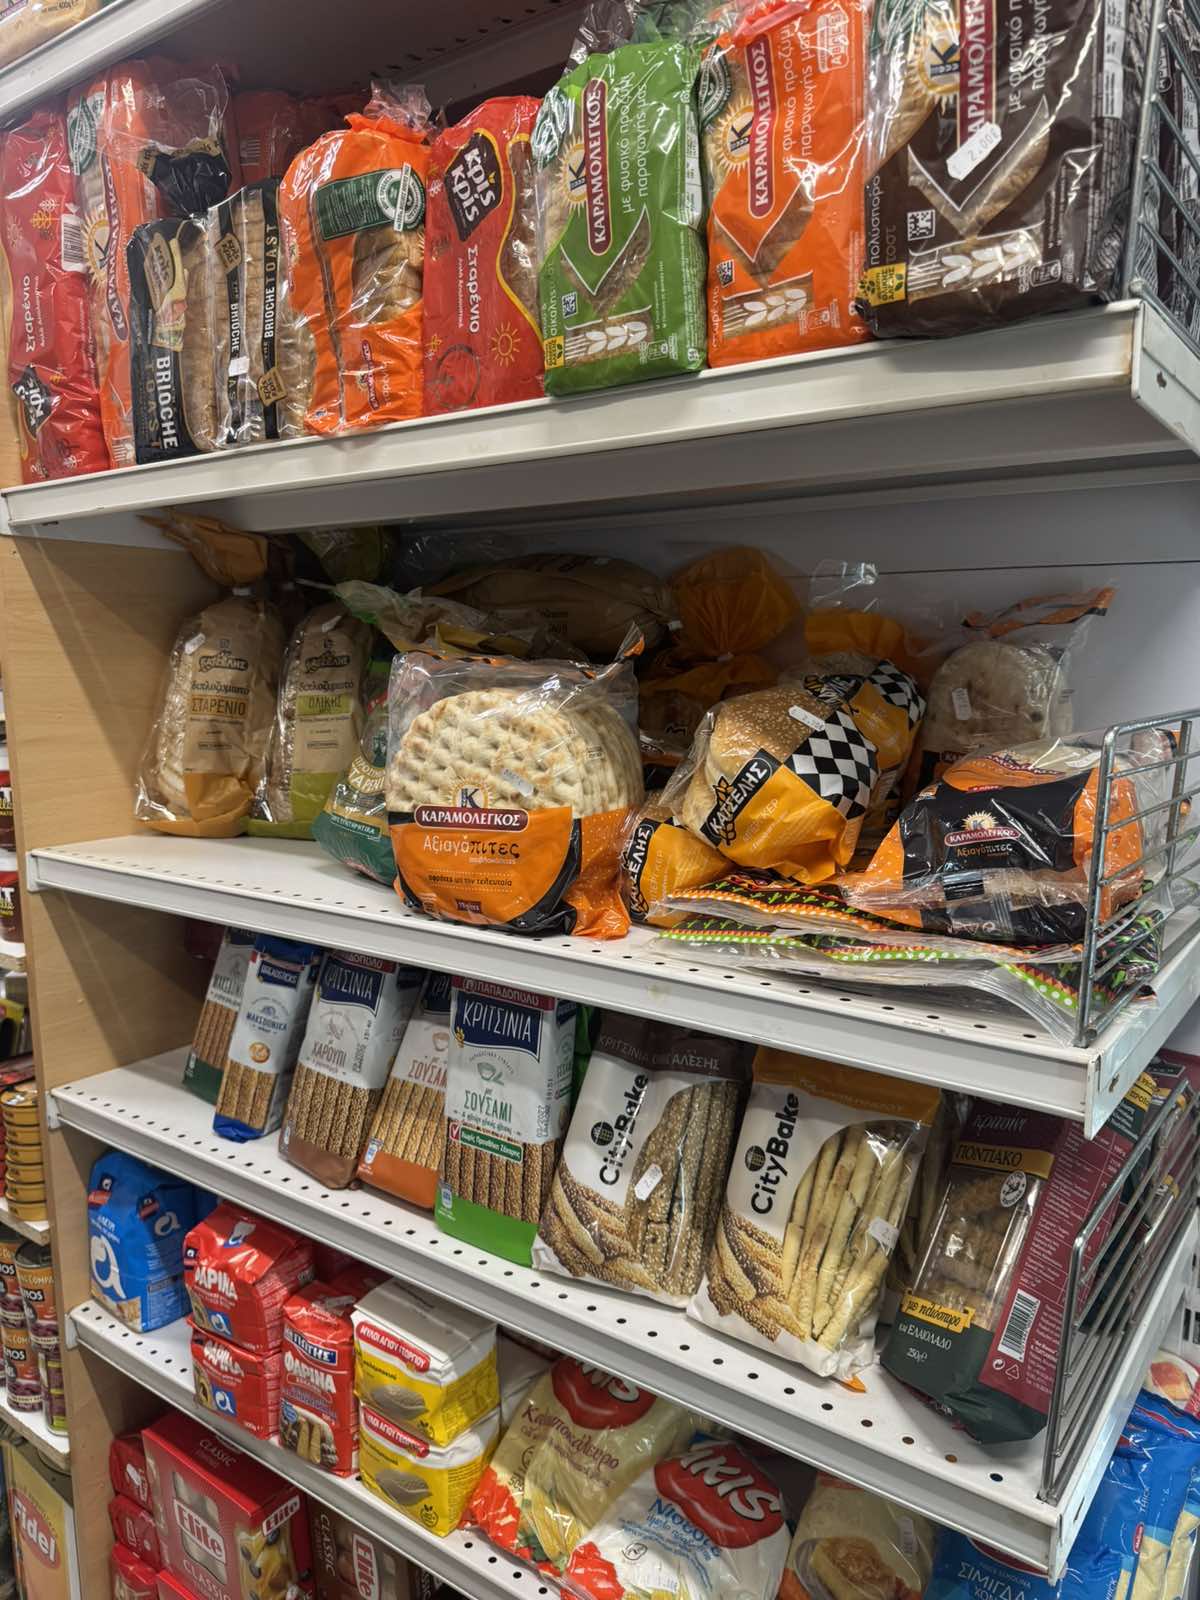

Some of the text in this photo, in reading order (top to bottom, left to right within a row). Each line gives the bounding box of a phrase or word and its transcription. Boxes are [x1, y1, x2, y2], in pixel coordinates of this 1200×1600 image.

[778, 25, 797, 91] προζύμι
[752, 42, 772, 206] ΚΑΡΑΜΟΛΕΓΚΟΣ
[782, 97, 797, 150] φυσικό
[799, 66, 816, 156] παραγωγής
[1008, 91, 1026, 112] με
[588, 89, 606, 243] ΚΑΡΑΜΟΛΕΓΚΟΣ
[618, 138, 633, 191] φυσικό
[634, 84, 651, 196] παραγωγής μας
[623, 196, 635, 213] με
[869, 176, 884, 265] πολύσπορο
[265, 224, 277, 285] TOAST
[886, 225, 896, 263] τοστ
[22, 275, 36, 353] Σταρένιο
[264, 287, 275, 338] BRIOCHE
[466, 244, 480, 333] Σταρένιο
[547, 289, 557, 336] σίκαλης
[230, 303, 240, 353] BRIOCHE
[155, 356, 179, 449] BRIOCHE
[192, 698, 245, 715] ΣΤΑΡΕΝΙΟ
[422, 811, 520, 826] ΚΑΡΑΜΟΛΕΓΚΟΣ
[710, 761, 768, 834] ΚΑΤΣΕΛΗΣ
[463, 1000, 532, 1043] ΚΡΙΤΣΙΝΙΑ
[408, 1060, 447, 1088] ΣΟΥΣΑΜ
[672, 1053, 721, 1070] ΑΛΕΣΗΣ
[464, 1089, 512, 1123] ΣΟΥΣΑΜΙ
[599, 1073, 649, 1185] CityBake
[751, 1092, 799, 1215] CityBake
[955, 1144, 1023, 1167] ΠΟΝΤΙΑΚΟ
[194, 1266, 238, 1301] ΦΑΡΙΝΑ
[907, 1324, 952, 1351] ΕΛΑΙΟΛΑΔΟ
[284, 1350, 331, 1393] ΦΑΡΙΝΑ
[199, 1438, 237, 1467] CLASSIC
[13, 1499, 56, 1565] Fidel
[175, 1503, 225, 1560] Elite
[263, 1499, 299, 1535] Elite
[320, 1514, 336, 1577] CLASSIC
[357, 1538, 375, 1597] Elite
